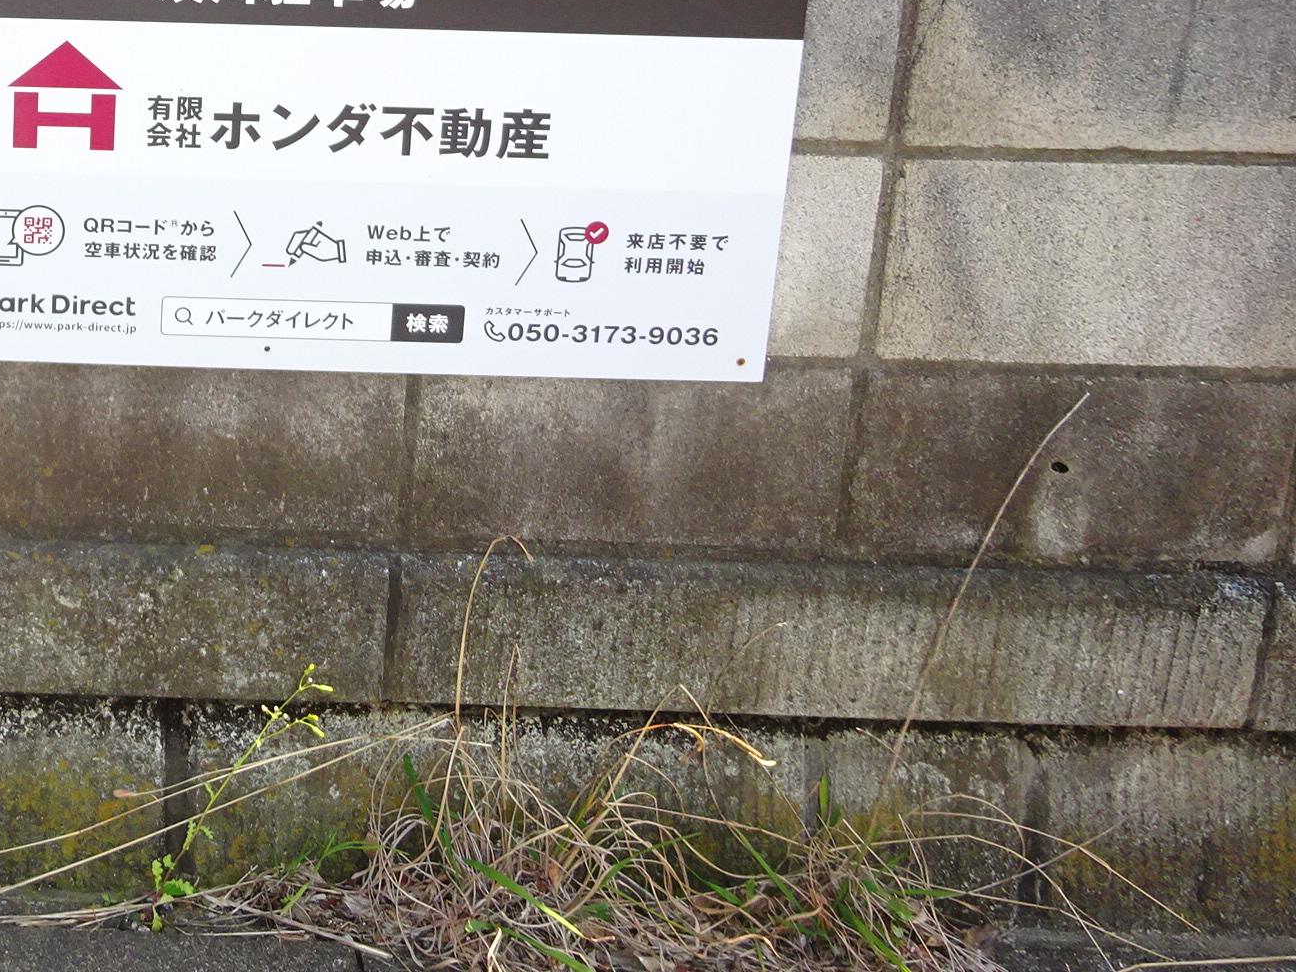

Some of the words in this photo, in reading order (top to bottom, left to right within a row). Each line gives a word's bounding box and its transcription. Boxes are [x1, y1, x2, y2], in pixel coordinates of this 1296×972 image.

[147, 95, 203, 121] 有限
[146, 122, 202, 149] 会社
[210, 102, 551, 159] ホンダ不動産
[367, 225, 451, 242] Web上で
[626, 232, 729, 251] 来店不要で
[84, 241, 216, 262] 空車状況を確認
[365, 249, 500, 268] 申込・審査・契約
[624, 257, 705, 275] 利用開始
[51, 294, 137, 316] Direct
[485, 307, 571, 318] カスタマーサポート
[205, 309, 354, 331] パークダイレクト
[406, 313, 449, 333] 検索
[507, 323, 719, 346] 050-3173-9036
